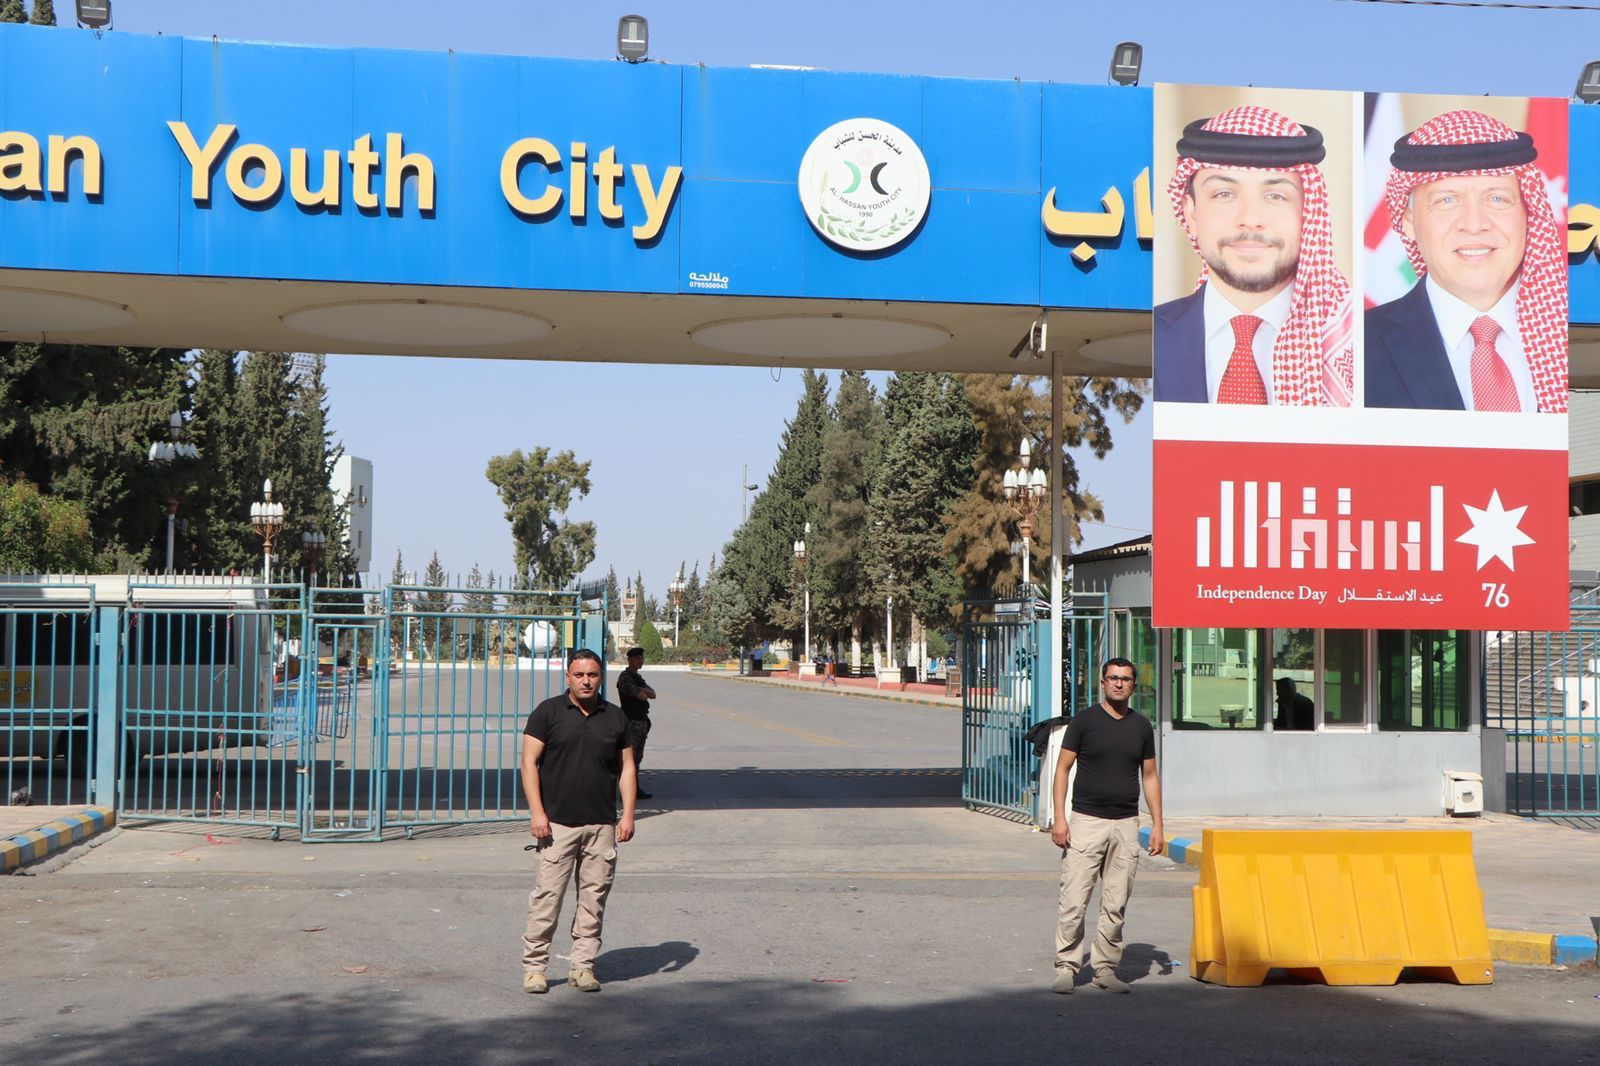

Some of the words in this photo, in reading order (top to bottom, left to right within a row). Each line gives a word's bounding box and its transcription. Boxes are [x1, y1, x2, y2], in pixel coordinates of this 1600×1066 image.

[857, 130, 882, 142] الحسن
[883, 135, 903, 156] مدينة
[166, 120, 436, 211] Youth
[500, 136, 683, 240] City
[867, 199, 890, 210] YOUTH
[890, 187, 903, 201] CITY
[1196, 584, 1295, 603] Independence
[1298, 585, 1328, 605] Day
[1419, 590, 1444, 604] عيد
[1481, 582, 1510, 609] 76
